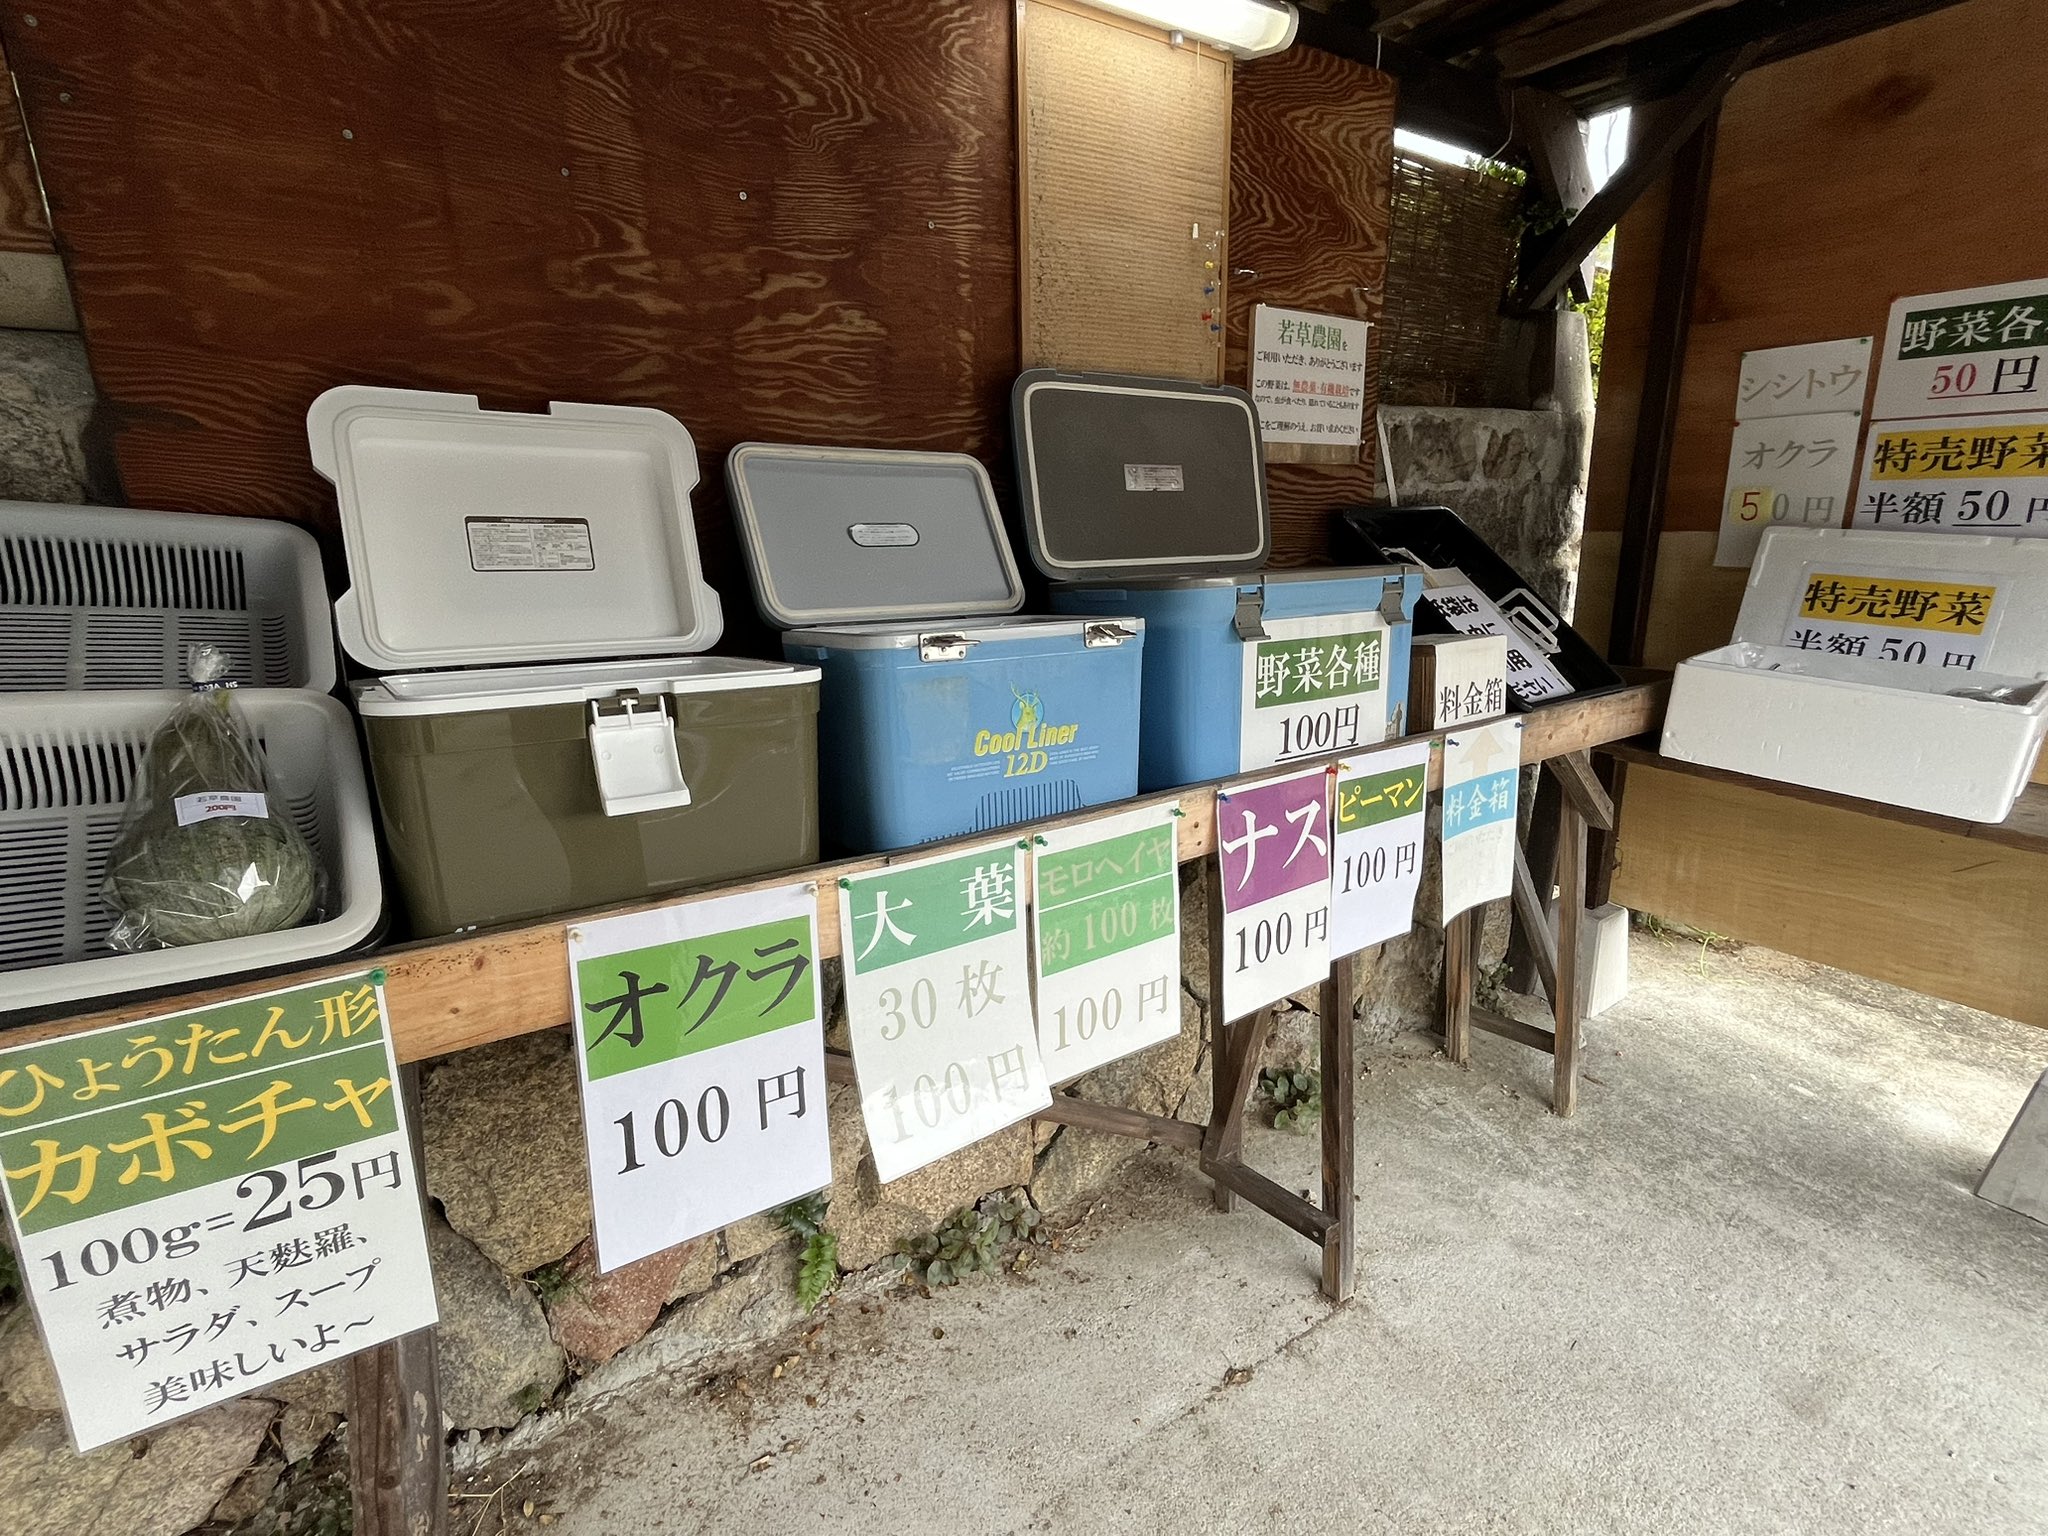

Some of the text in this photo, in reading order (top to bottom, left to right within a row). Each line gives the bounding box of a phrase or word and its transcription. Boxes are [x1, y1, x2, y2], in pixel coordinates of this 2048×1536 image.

[1278, 319, 1348, 351] 若草農園を
[1902, 305, 2048, 354] 野菜各
[1741, 364, 1862, 403] シシトウ
[1931, 355, 2040, 394] 50 円
[1740, 439, 1840, 471] オクラ
[1802, 494, 1834, 523] 円
[1860, 491, 1947, 526] 半額
[1957, 490, 2010, 522] 50
[1803, 580, 1992, 627] 特売野菜
[1256, 640, 1381, 699] 野菜各種
[1439, 677, 1503, 723] 料金箱
[974, 725, 1024, 757] Cool
[1027, 722, 1079, 750] Liner
[1279, 703, 1361, 756] 100円
[1003, 751, 1049, 778] 12D
[1338, 778, 1424, 823] ピーマン
[1446, 779, 1511, 827] 料金箱
[1039, 836, 1173, 898] モロヘイヤ
[1222, 800, 1328, 892] ナス
[1341, 847, 1386, 894] 100
[1395, 841, 1416, 879] 円
[1041, 896, 1175, 967] 約 100 枚
[1235, 906, 1329, 974] 100 円
[584, 938, 810, 1052] オクラ
[878, 959, 1006, 1042] 30 枚
[1053, 974, 1169, 1052] 100 円
[0, 984, 382, 1117] ひょうたん形
[613, 1065, 807, 1176] 100 円
[882, 1043, 1030, 1145] 100 円
[5, 1076, 392, 1220] カボチャ
[115, 1256, 383, 1368] サラダ、スープ
